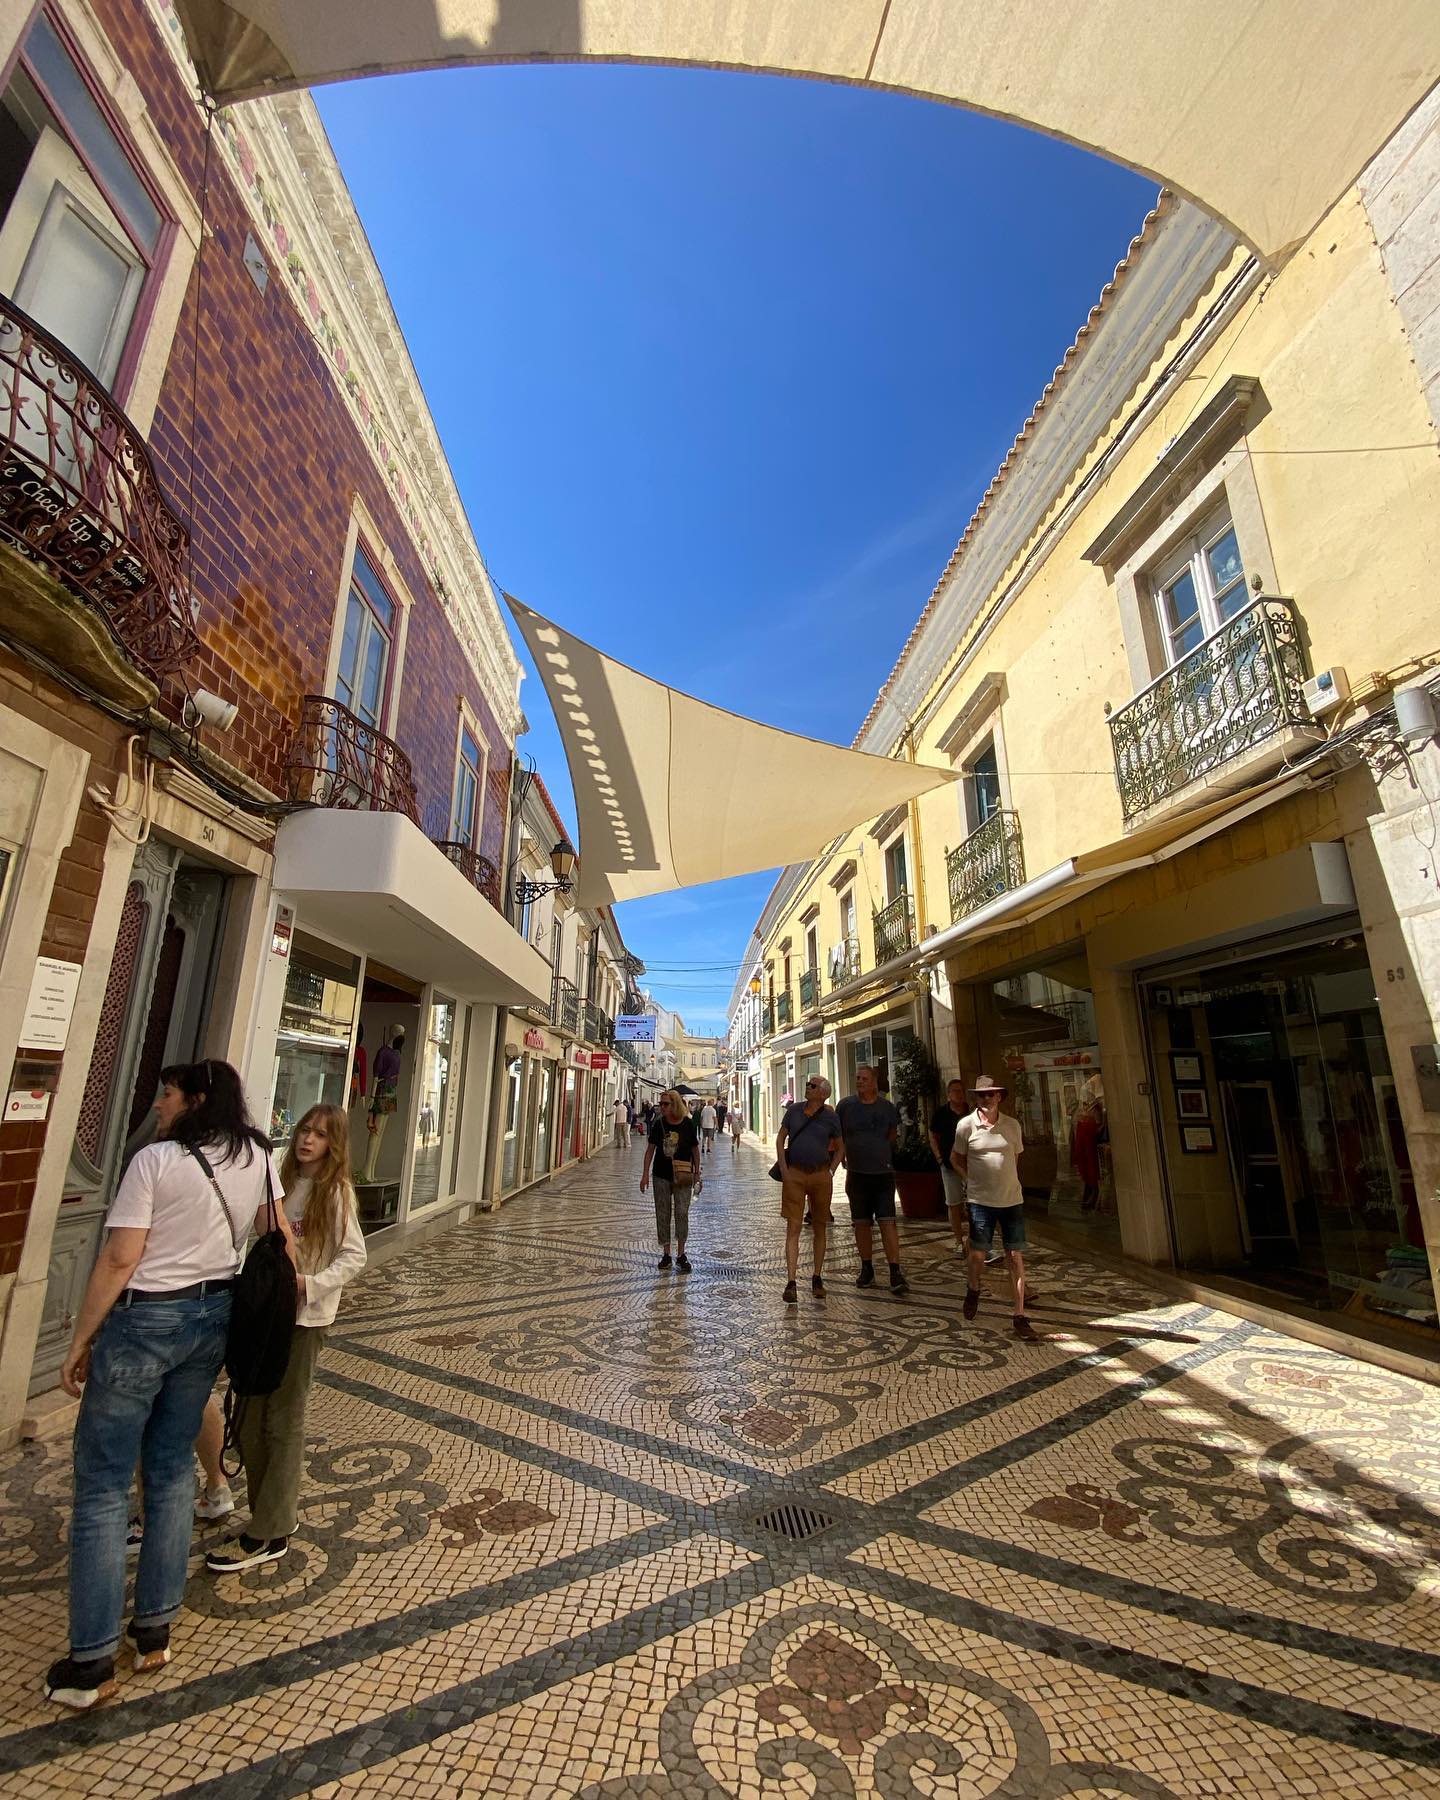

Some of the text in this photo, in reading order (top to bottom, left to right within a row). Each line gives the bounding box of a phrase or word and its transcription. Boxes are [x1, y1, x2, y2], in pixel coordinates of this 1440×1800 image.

[21, 480, 64, 521] Check
[68, 517, 92, 545] Up
[202, 825, 215, 843] 50
[1386, 967, 1406, 982] 53
